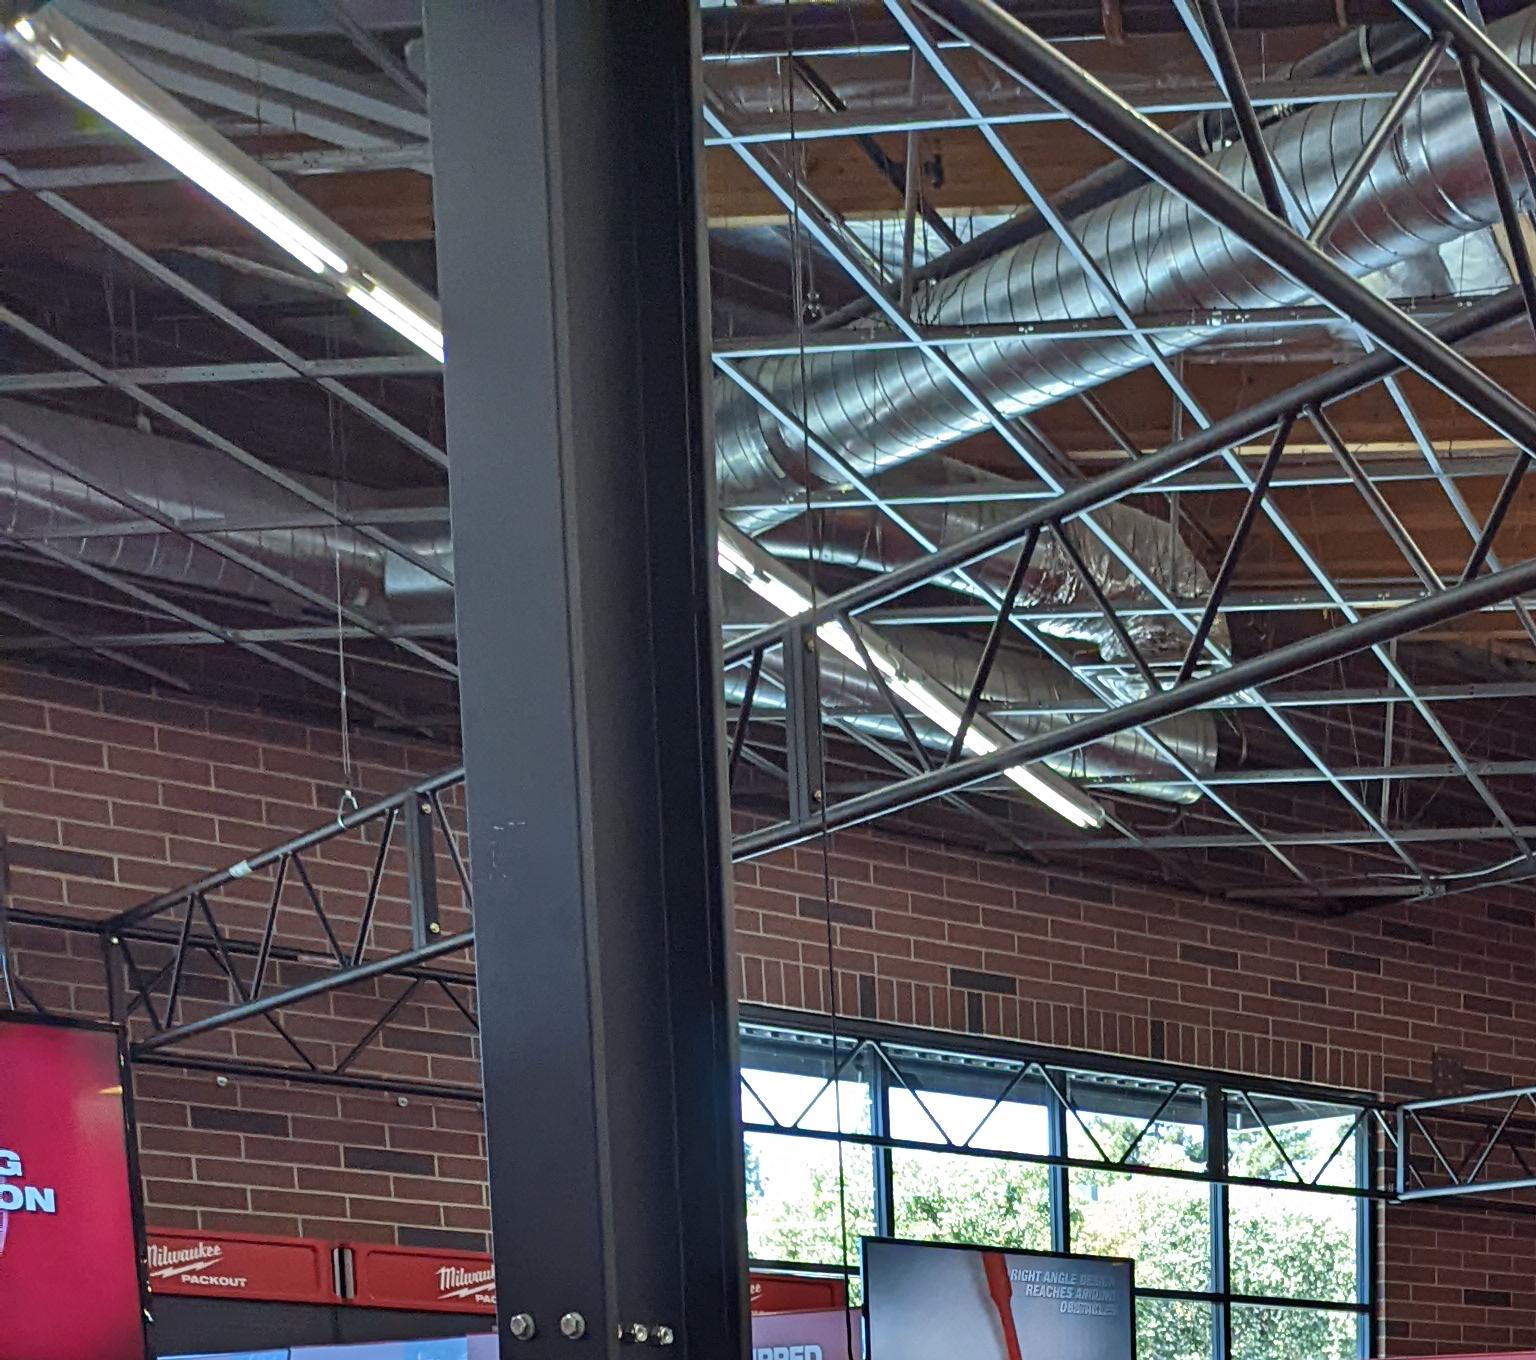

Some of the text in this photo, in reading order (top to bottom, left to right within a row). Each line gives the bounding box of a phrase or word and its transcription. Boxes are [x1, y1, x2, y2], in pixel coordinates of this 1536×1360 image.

[182, 1274, 247, 1288] PACKOUT
[1011, 1269, 1042, 1281] RIGHT
[1043, 1271, 1077, 1284] ANGLE
[1026, 1284, 1073, 1298] REACHES
